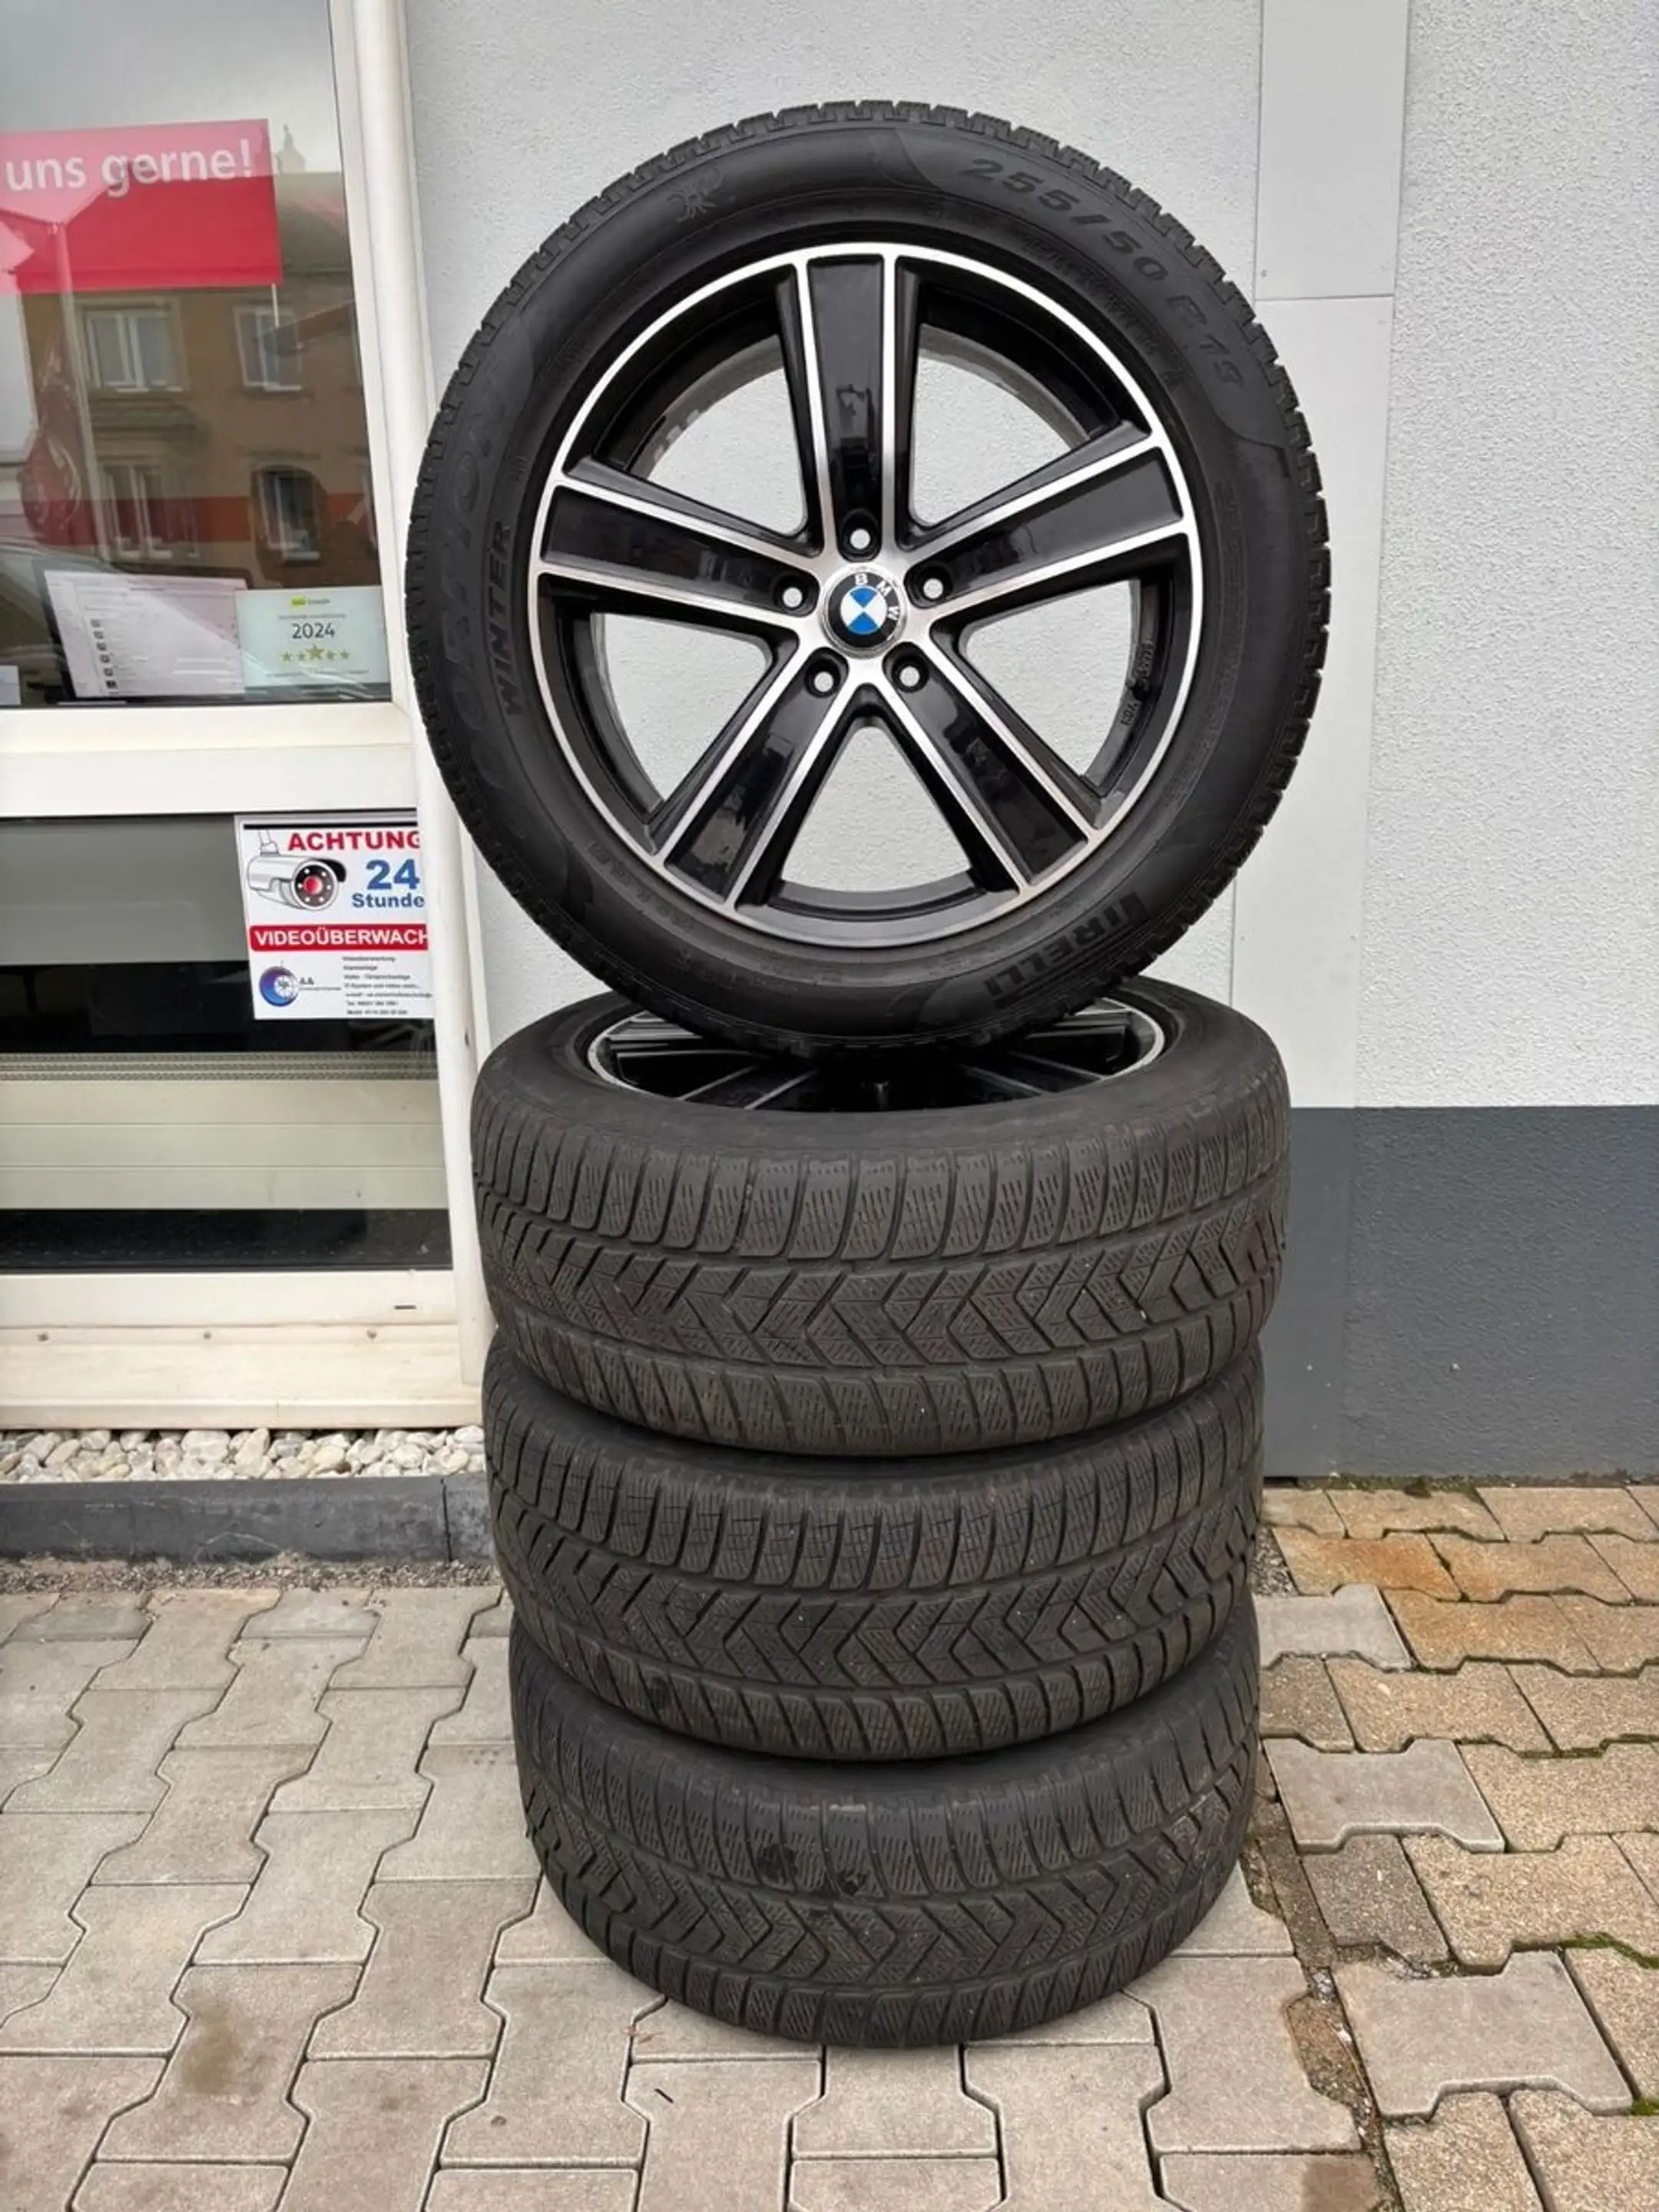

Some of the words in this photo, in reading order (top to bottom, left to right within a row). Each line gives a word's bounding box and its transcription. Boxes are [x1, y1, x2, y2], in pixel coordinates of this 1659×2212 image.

[6, 156, 86, 190] uns
[101, 138, 252, 197] gerne!
[962, 157, 1169, 281] 255/50
[485, 520, 521, 716] WINTER
[854, 573, 899, 620] BMW
[292, 622, 336, 640] 2024
[365, 859, 420, 890] 24
